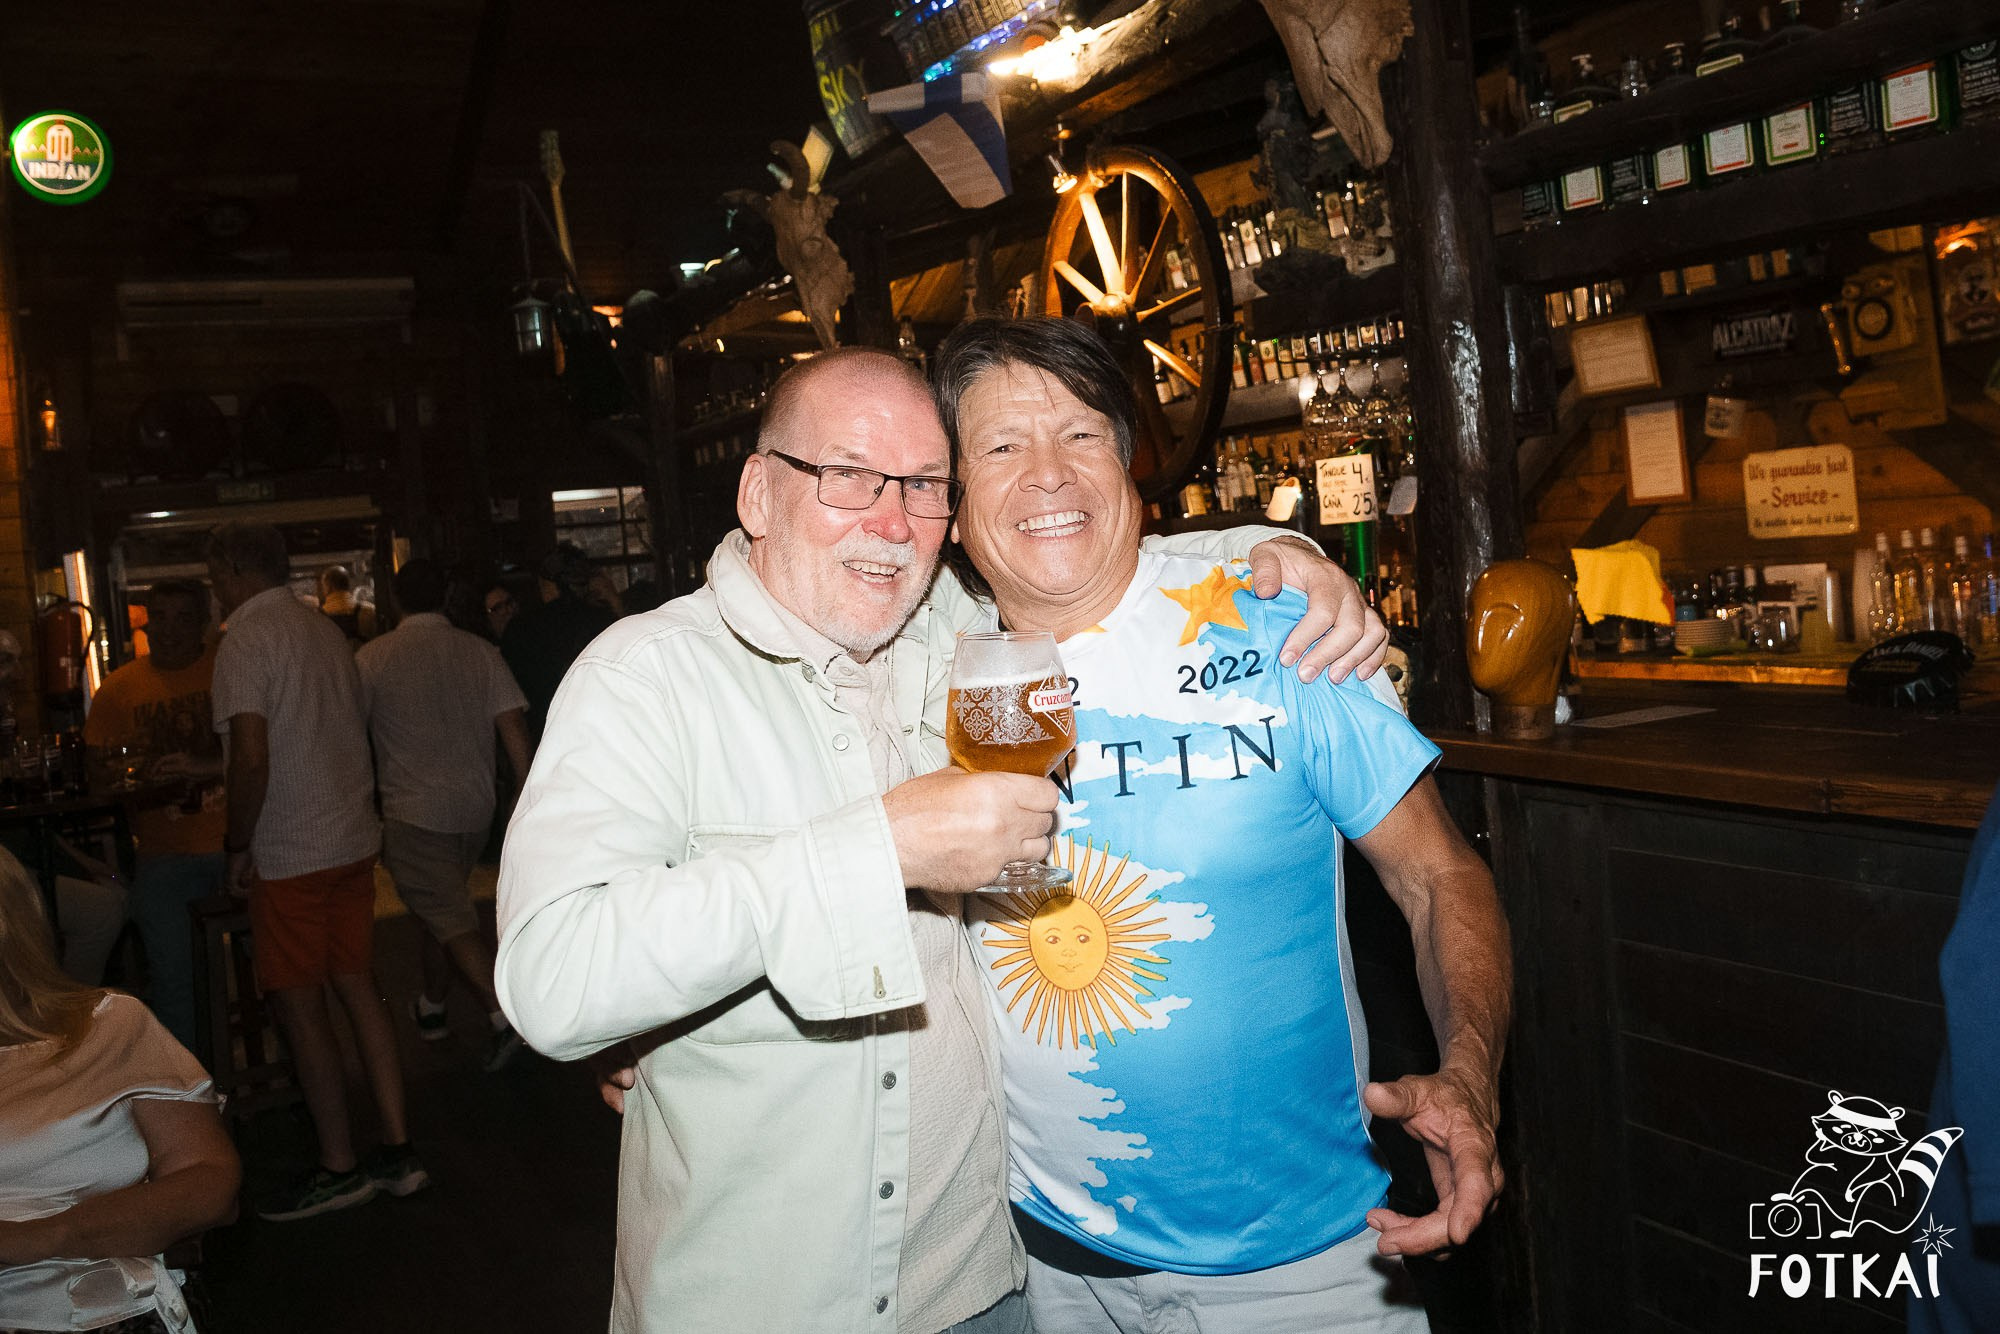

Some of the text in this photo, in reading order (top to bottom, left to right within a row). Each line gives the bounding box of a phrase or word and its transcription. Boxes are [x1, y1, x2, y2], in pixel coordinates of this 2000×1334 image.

[28, 160, 92, 181] INDIAN
[1713, 311, 1793, 351] ALCATRAZ
[1177, 649, 1264, 694] 2022
[1034, 693, 1072, 708] Cruzcam
